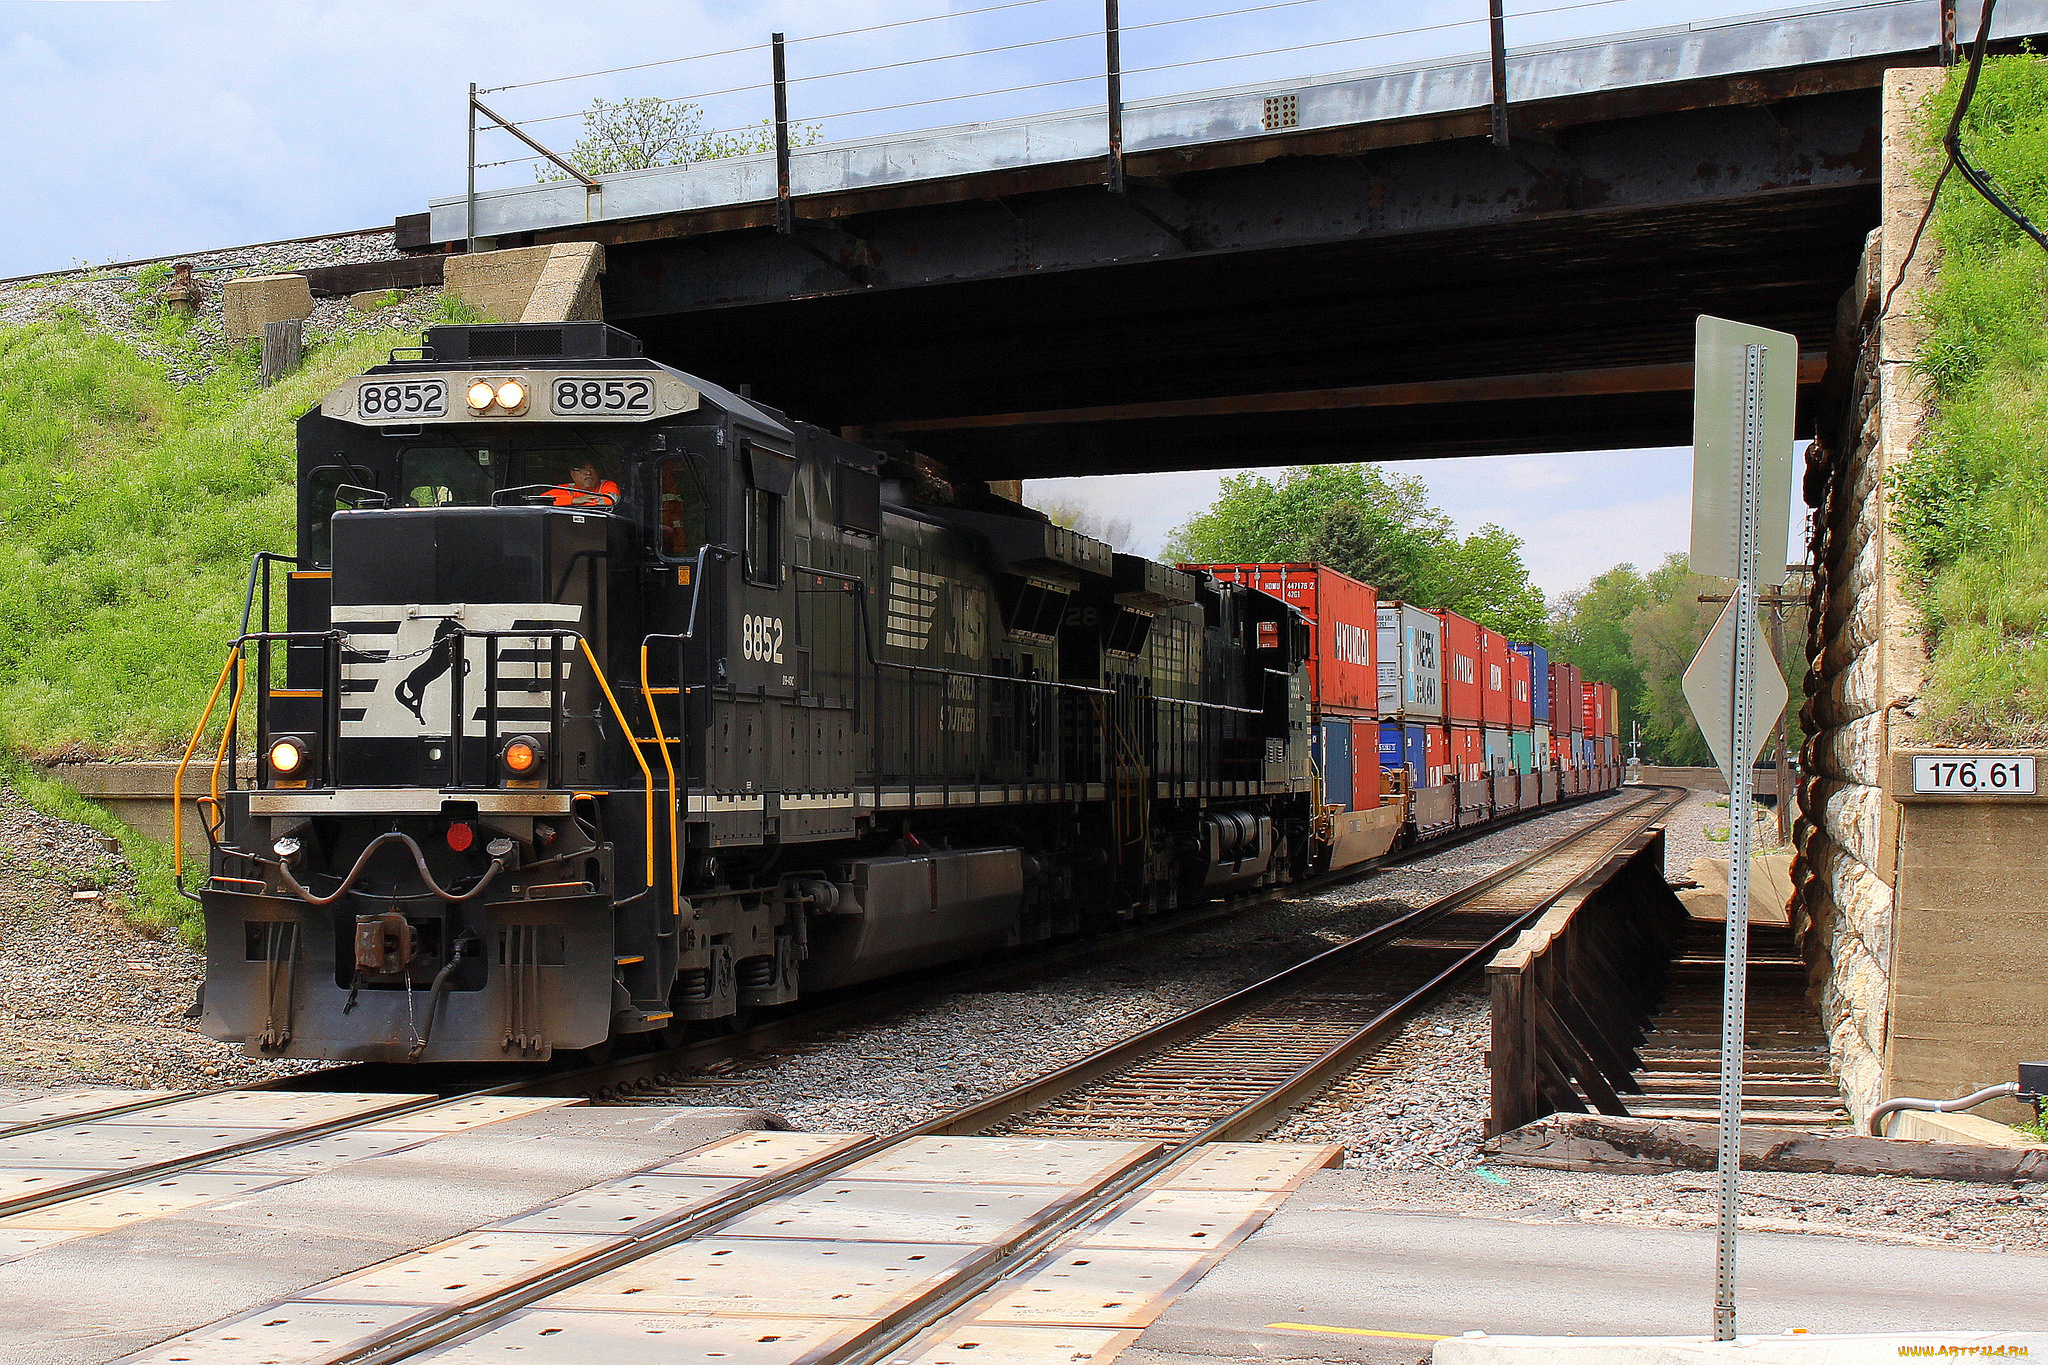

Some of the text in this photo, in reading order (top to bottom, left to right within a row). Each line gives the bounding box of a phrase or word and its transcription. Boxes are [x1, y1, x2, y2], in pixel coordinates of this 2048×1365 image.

[364, 384, 443, 414] 8852
[558, 382, 649, 410] 8852
[743, 613, 783, 664] 8852
[941, 675, 976, 701] ORFOL
[1929, 762, 2020, 787] 176.61
